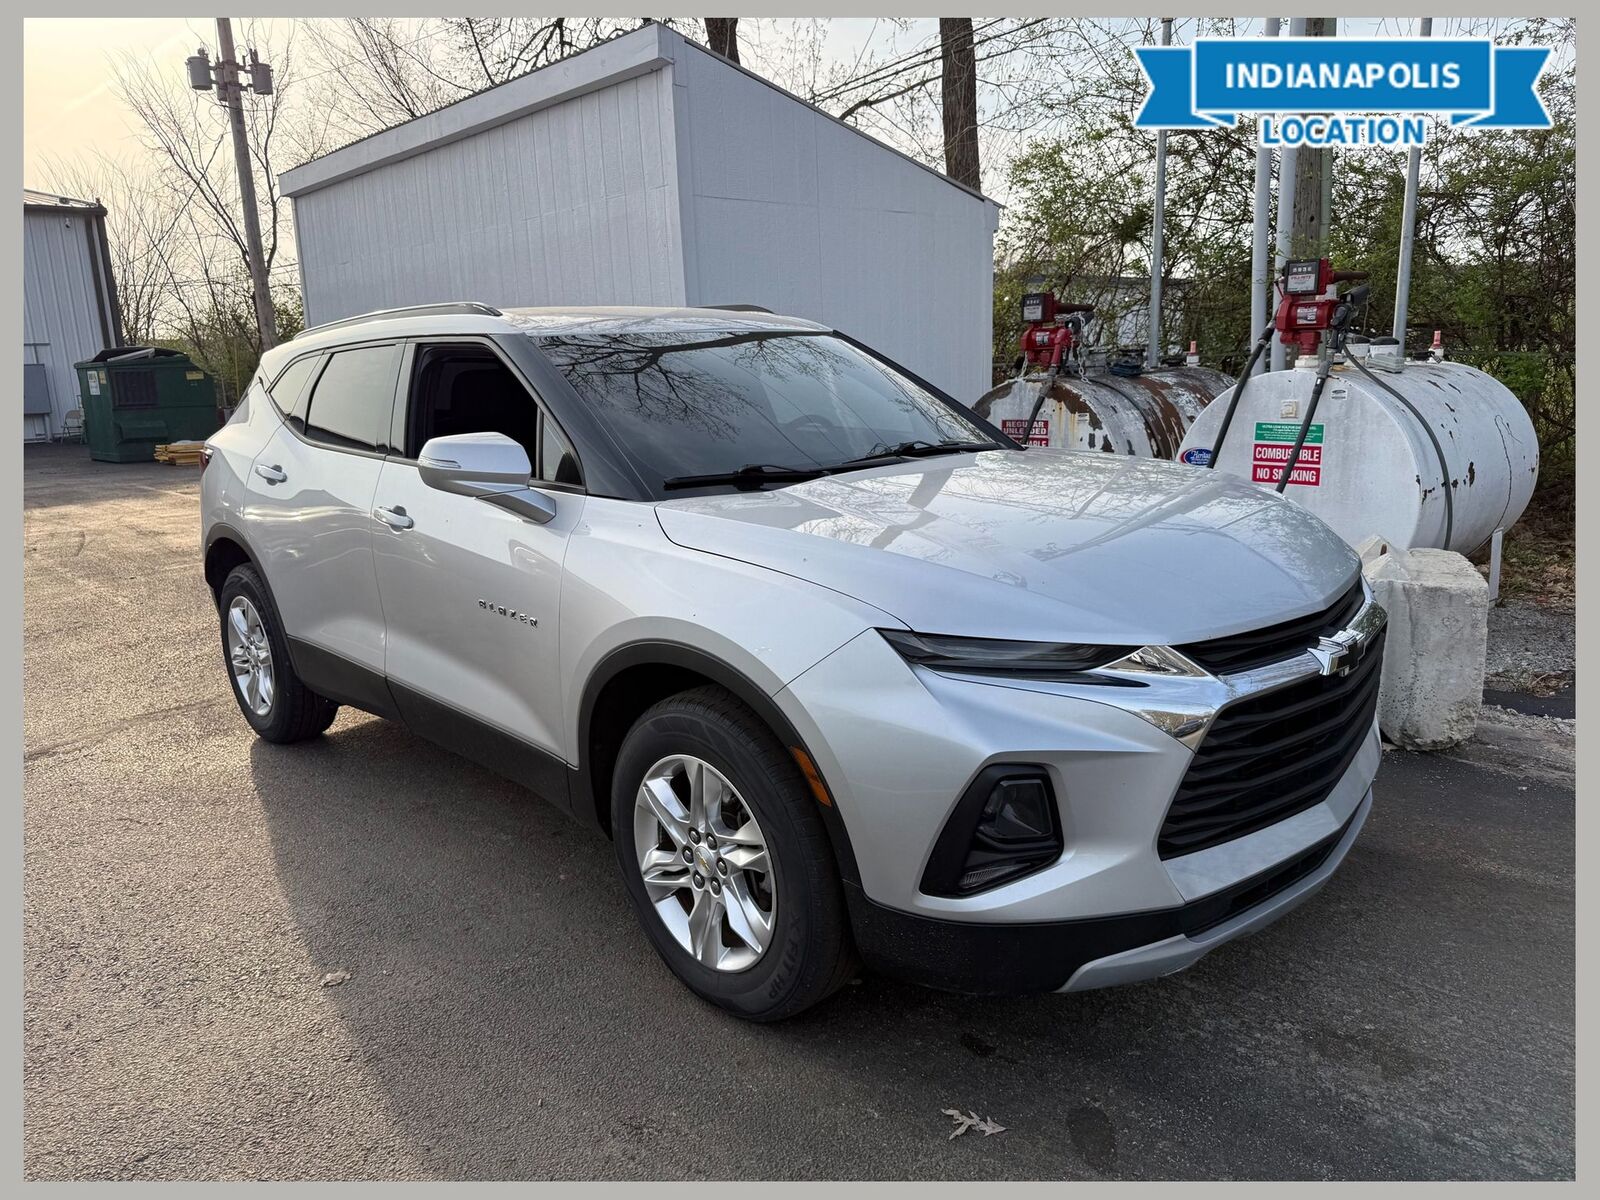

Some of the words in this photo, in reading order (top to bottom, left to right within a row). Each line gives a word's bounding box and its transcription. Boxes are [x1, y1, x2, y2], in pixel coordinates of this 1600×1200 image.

[1255, 447, 1320, 462] COMBUSIBLE
[1256, 467, 1270, 480] NO
[478, 599, 538, 628] BLAZER
